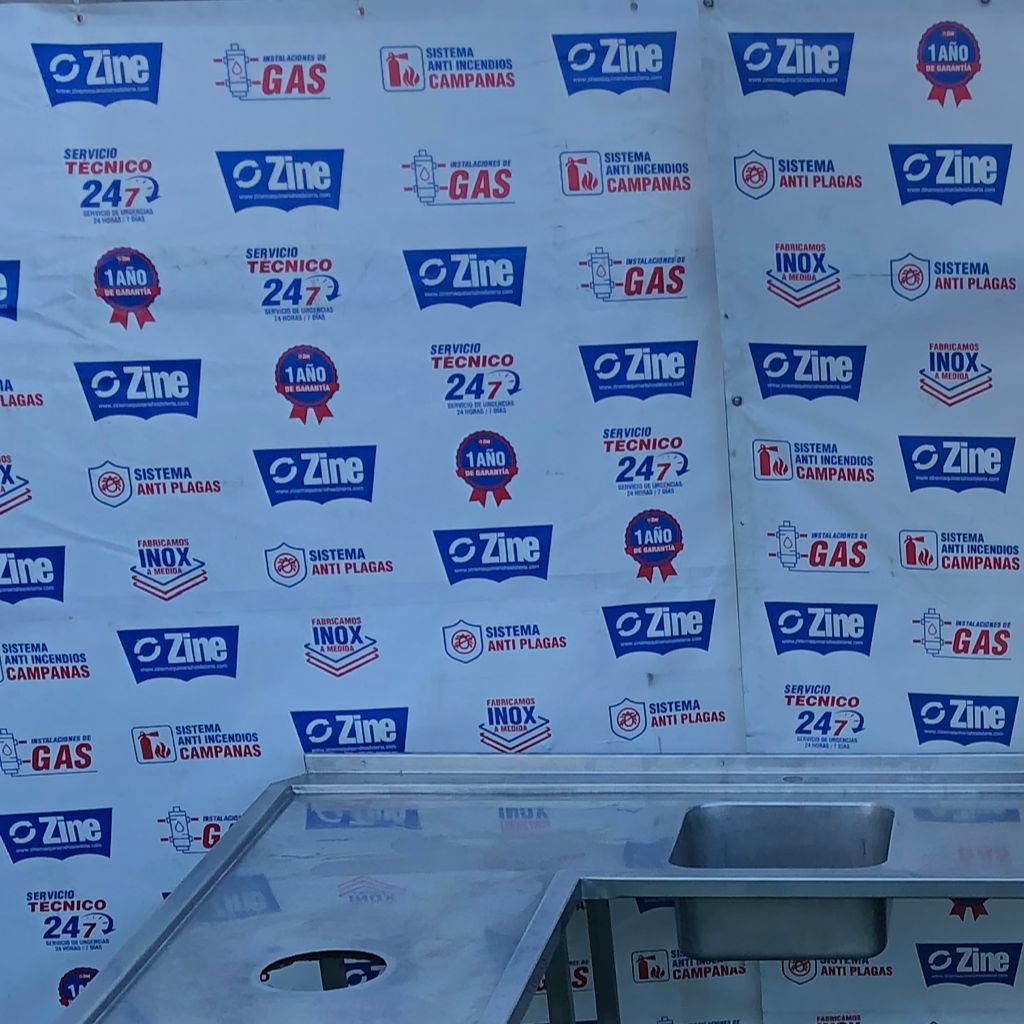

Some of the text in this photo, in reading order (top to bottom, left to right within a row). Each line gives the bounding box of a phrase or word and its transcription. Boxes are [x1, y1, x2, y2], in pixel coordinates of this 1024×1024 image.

[425, 47, 474, 59] SISTEMA
[600, 38, 663, 73] Zine
[776, 38, 839, 74] Zine
[83, 49, 149, 85] Zine
[427, 58, 513, 72] ANTI INCENDIOS
[262, 63, 327, 95] GAS
[429, 72, 515, 89] CAMPANAS
[63, 147, 118, 160] SERVICIO
[265, 155, 331, 190] Zine
[778, 159, 835, 173] SISTEMA
[936, 149, 997, 184] Zine
[449, 168, 512, 200] GAS
[779, 175, 862, 188] ANTI PLAGAS
[775, 243, 826, 252] FABRICAMOS
[450, 254, 514, 288] Zine
[775, 253, 827, 274] INOX
[934, 261, 990, 275] SISTEMA
[624, 265, 685, 296] GAS
[788, 273, 817, 281] MEDIDA
[935, 277, 1016, 290] ANTI PLAGAS
[625, 347, 685, 381] Zine
[793, 349, 853, 382] Zine
[123, 366, 189, 399] Zine
[794, 442, 838, 454] SISTEMA
[943, 441, 1001, 474] Zine
[301, 452, 364, 485] Zine
[795, 454, 873, 466] ANTI INCENDIOS
[134, 467, 192, 481] SISTEMA
[796, 466, 875, 482] CAMPANAS
[137, 480, 221, 495] ANTI PLAGAS
[309, 548, 366, 562] SISTEMA
[479, 532, 540, 564] Zine
[809, 540, 868, 568] GAS
[312, 560, 393, 576] ANTI PLAGAS
[311, 617, 362, 626] FABRICAMOS
[645, 607, 703, 638] Zine
[807, 607, 864, 638] Zine
[312, 626, 364, 646] INOX
[952, 628, 1010, 656] GAS
[3, 643, 48, 654] SISTEMA
[164, 632, 227, 664] Zine
[5, 653, 87, 665] ANTI INCENDIOS
[6, 664, 90, 681] CAMPANAS
[649, 699, 701, 715] SISTEMA
[950, 699, 1005, 729] Zine
[651, 711, 726, 728] ANTI PLAGAS
[335, 716, 394, 744] Zine
[32, 743, 92, 771] GAS
[40, 816, 101, 844] Zine
[26, 890, 74, 901] SERVICIO
[956, 947, 1009, 972] Zine
[820, 963, 893, 978] ANTI PLAGAS
